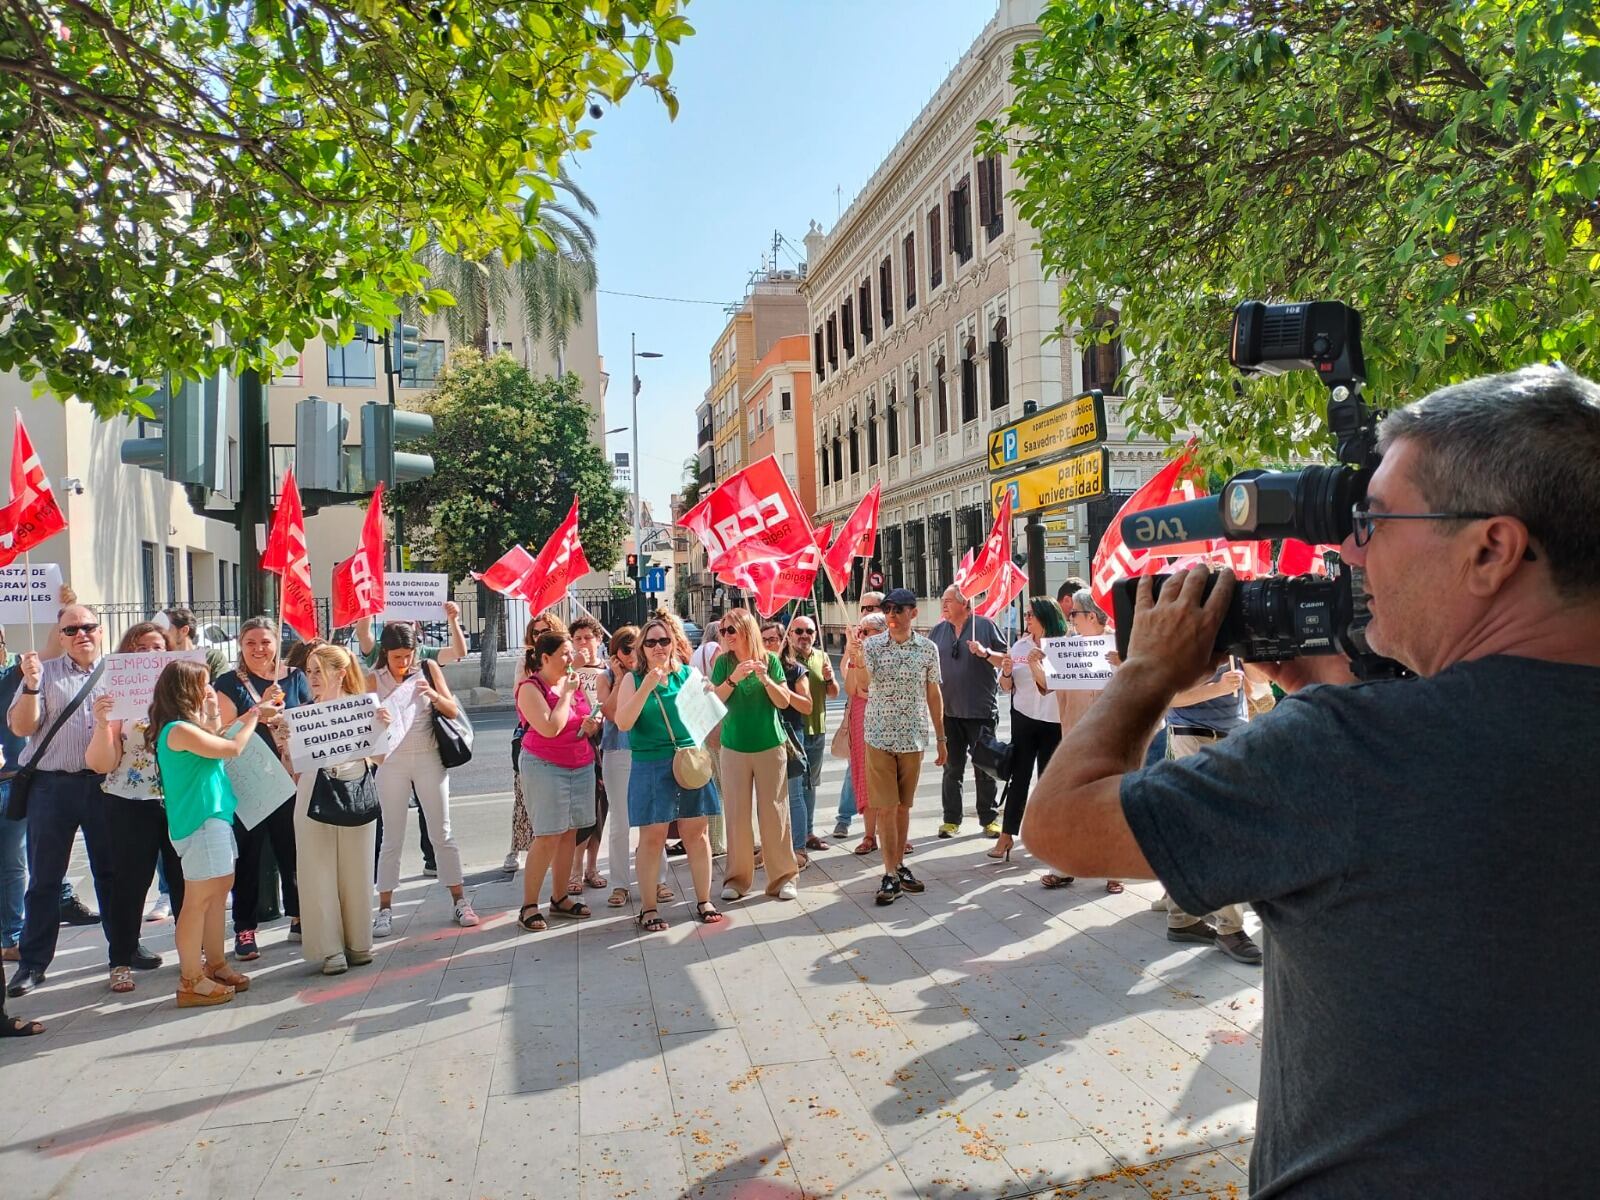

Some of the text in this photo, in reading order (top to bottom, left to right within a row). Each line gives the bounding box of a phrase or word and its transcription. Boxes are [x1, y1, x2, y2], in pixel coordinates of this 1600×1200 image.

[1032, 413, 1068, 432] aparcamiento
[1058, 457, 1099, 484] parking
[1038, 476, 1099, 506] universidad
[1135, 516, 1188, 542] tve
[1300, 601, 1324, 609] Canon
[1078, 671, 1113, 679] SALARIO
[291, 697, 373, 720] IGUAL TRABAJO
[295, 710, 375, 733] IGUAL SALARIO
[303, 724, 373, 746] EQUIDAD EN
[311, 740, 371, 759] LA AGE YA
